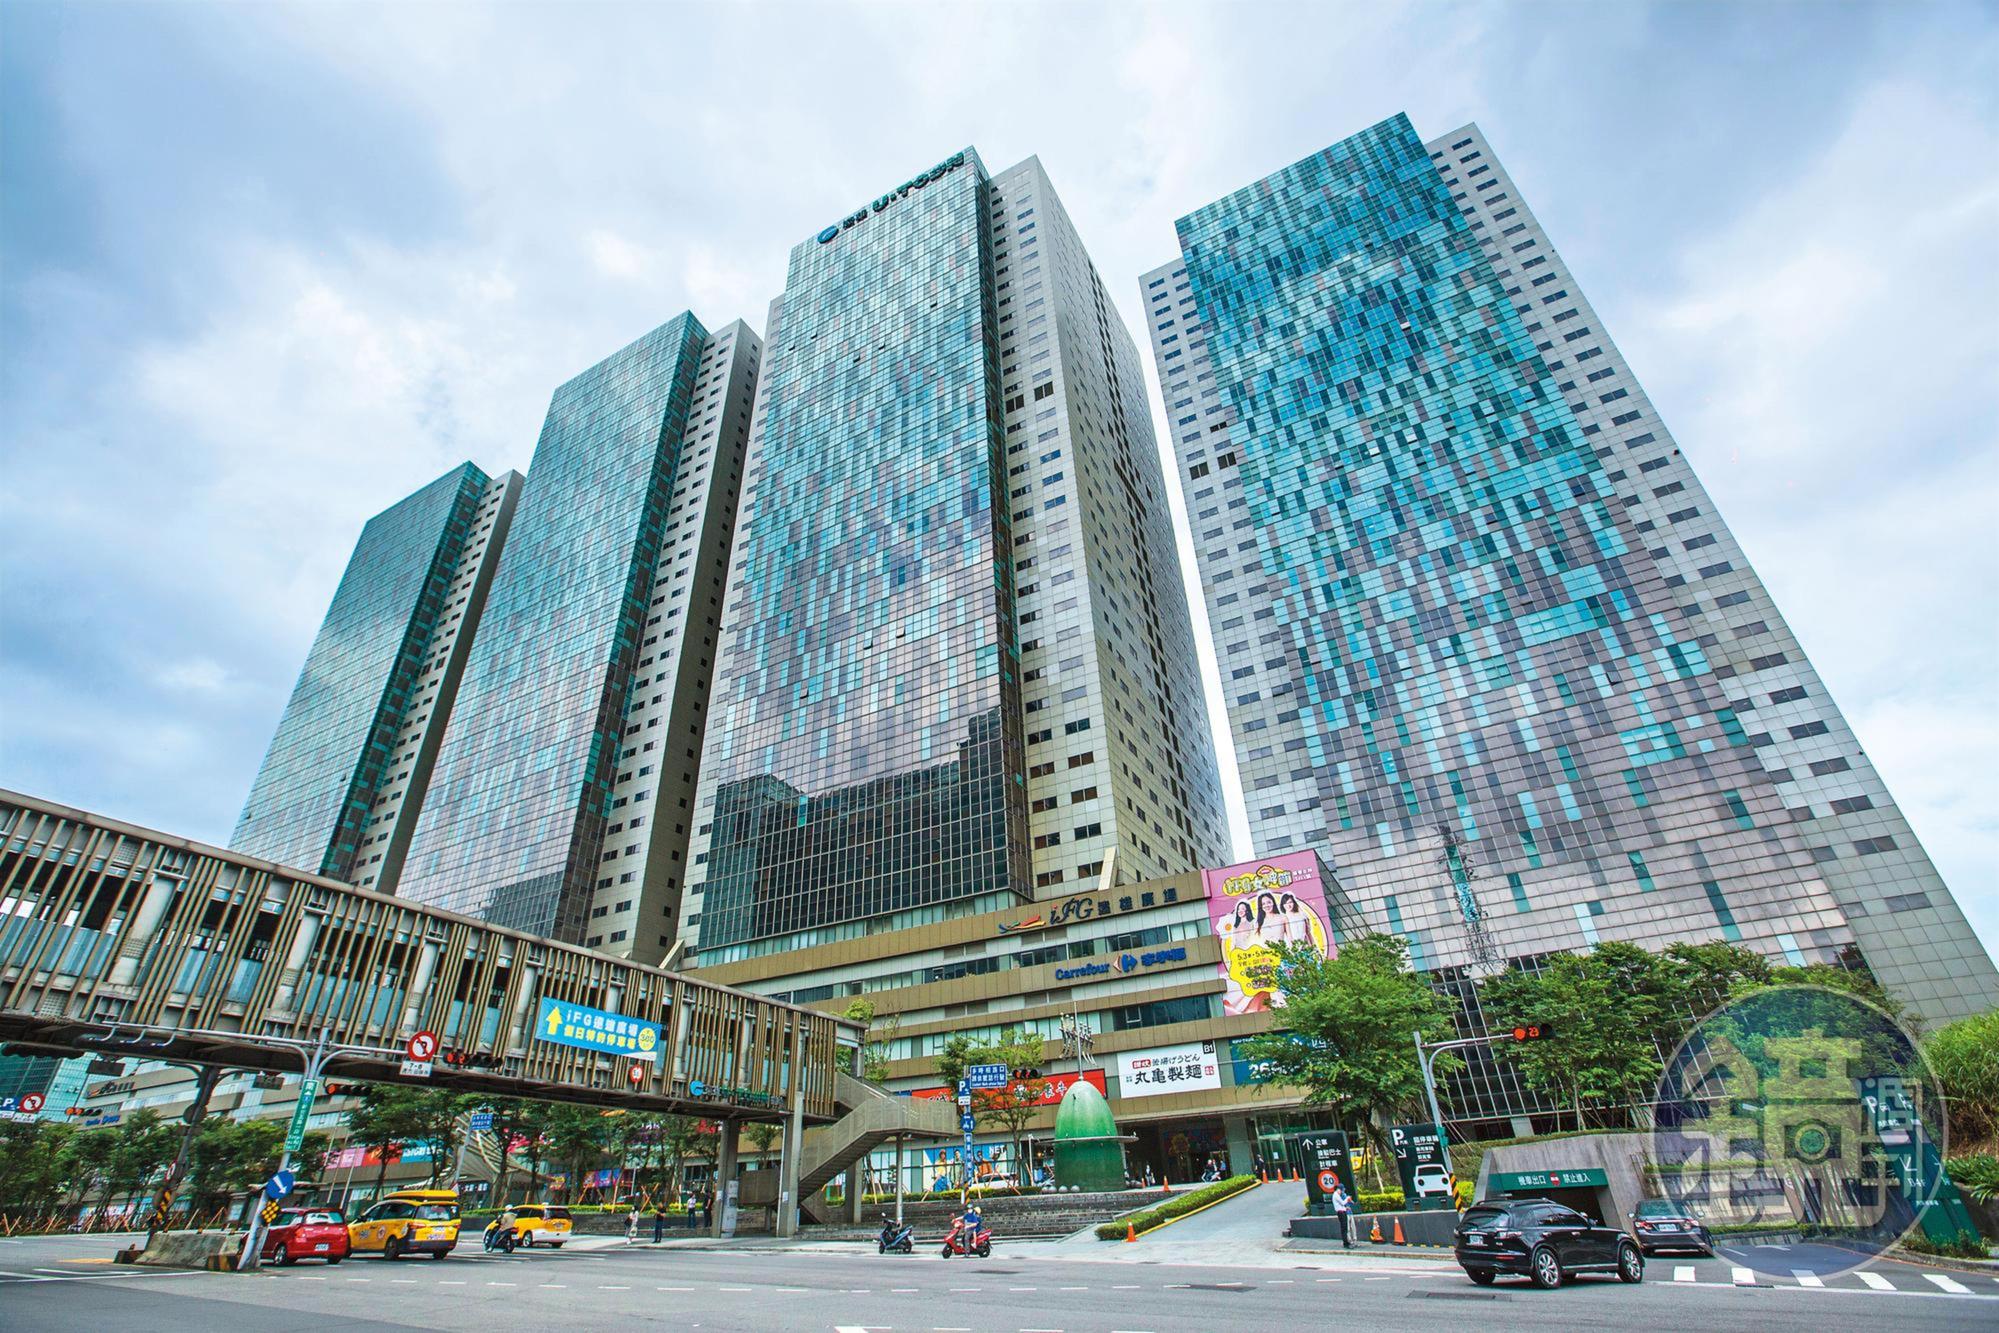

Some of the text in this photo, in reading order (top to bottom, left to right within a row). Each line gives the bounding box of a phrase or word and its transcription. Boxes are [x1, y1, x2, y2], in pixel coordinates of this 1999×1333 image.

[1055, 962, 1110, 980] Carrefour
[1203, 1044, 1215, 1054] B1
[959, 1080, 967, 1092] P
[3, 1097, 14, 1108] P
[1391, 1129, 1404, 1146] P
[988, 1145, 1005, 1154] NET
[1323, 1176, 1335, 1185] 20
